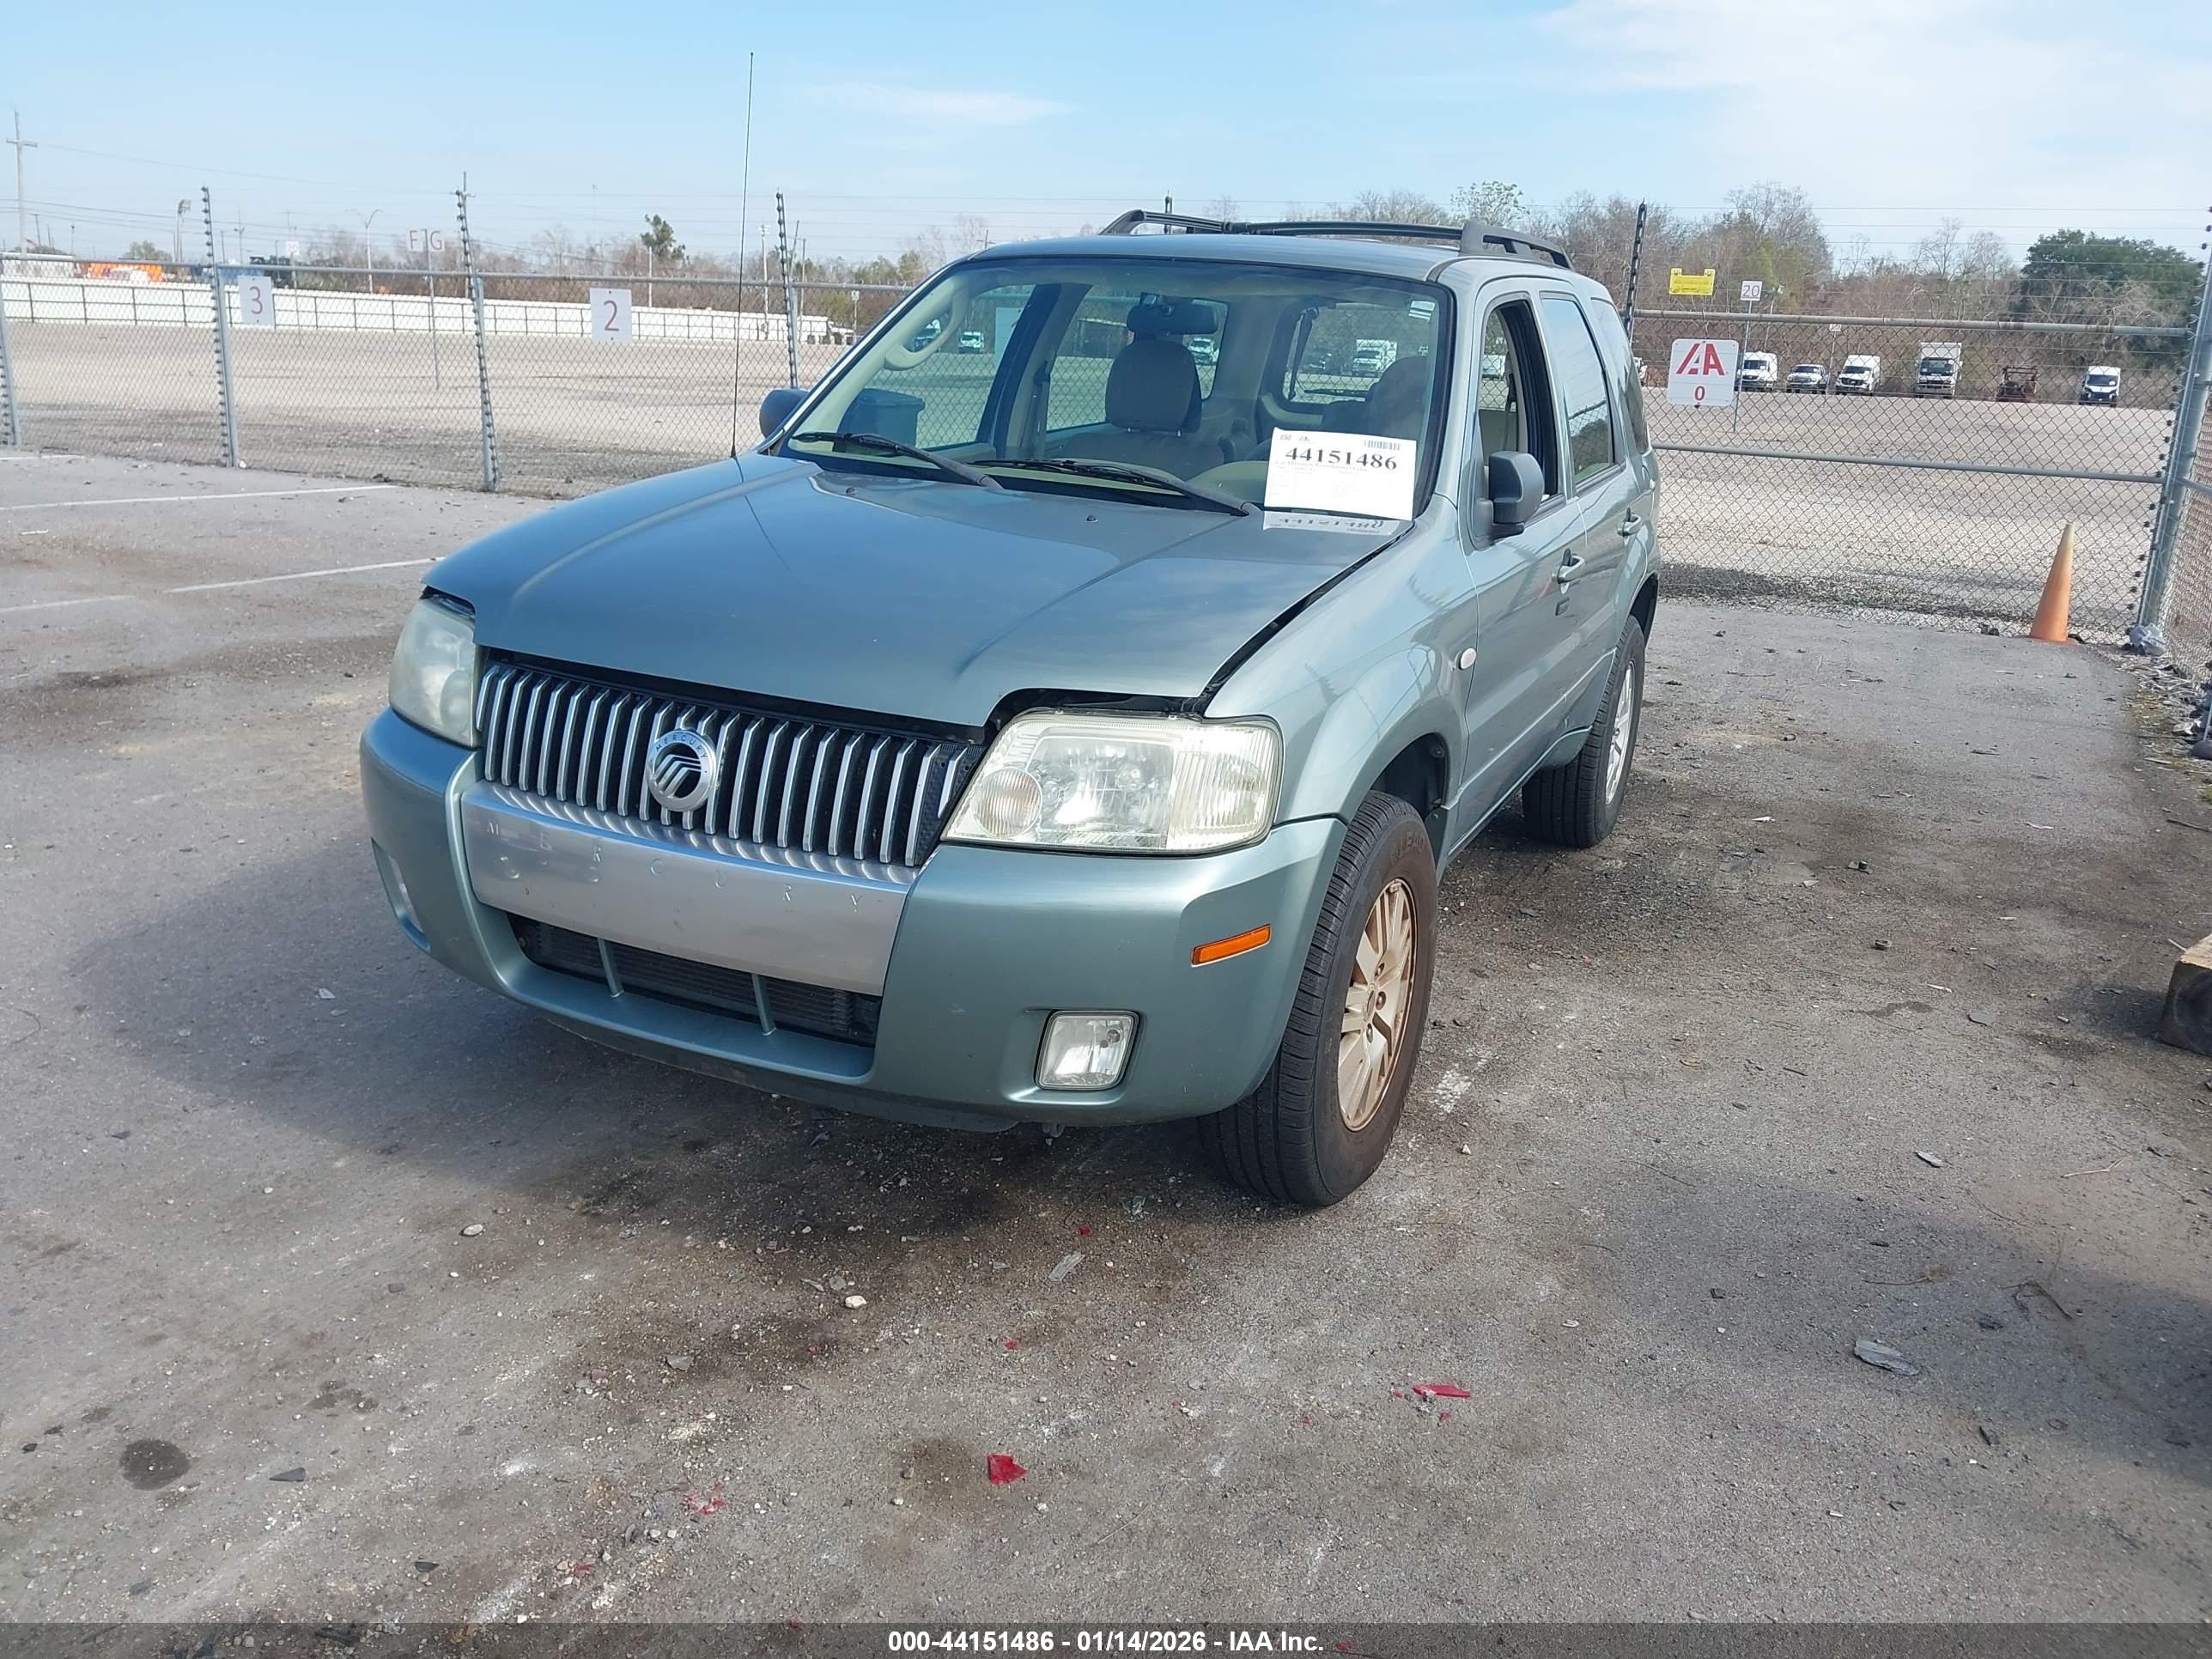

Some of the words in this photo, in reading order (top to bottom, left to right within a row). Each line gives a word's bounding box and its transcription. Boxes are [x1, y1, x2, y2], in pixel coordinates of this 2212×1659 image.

[409, 229, 418, 250] F
[429, 230, 442, 250] G
[249, 285, 263, 315] 3
[1742, 284, 1760, 298] 20
[604, 300, 619, 331] 2
[1694, 386, 1705, 401] 0
[1285, 447, 1397, 471] 44151486
[655, 734, 708, 758] MERCURY
[487, 822, 864, 914] MERCURY
